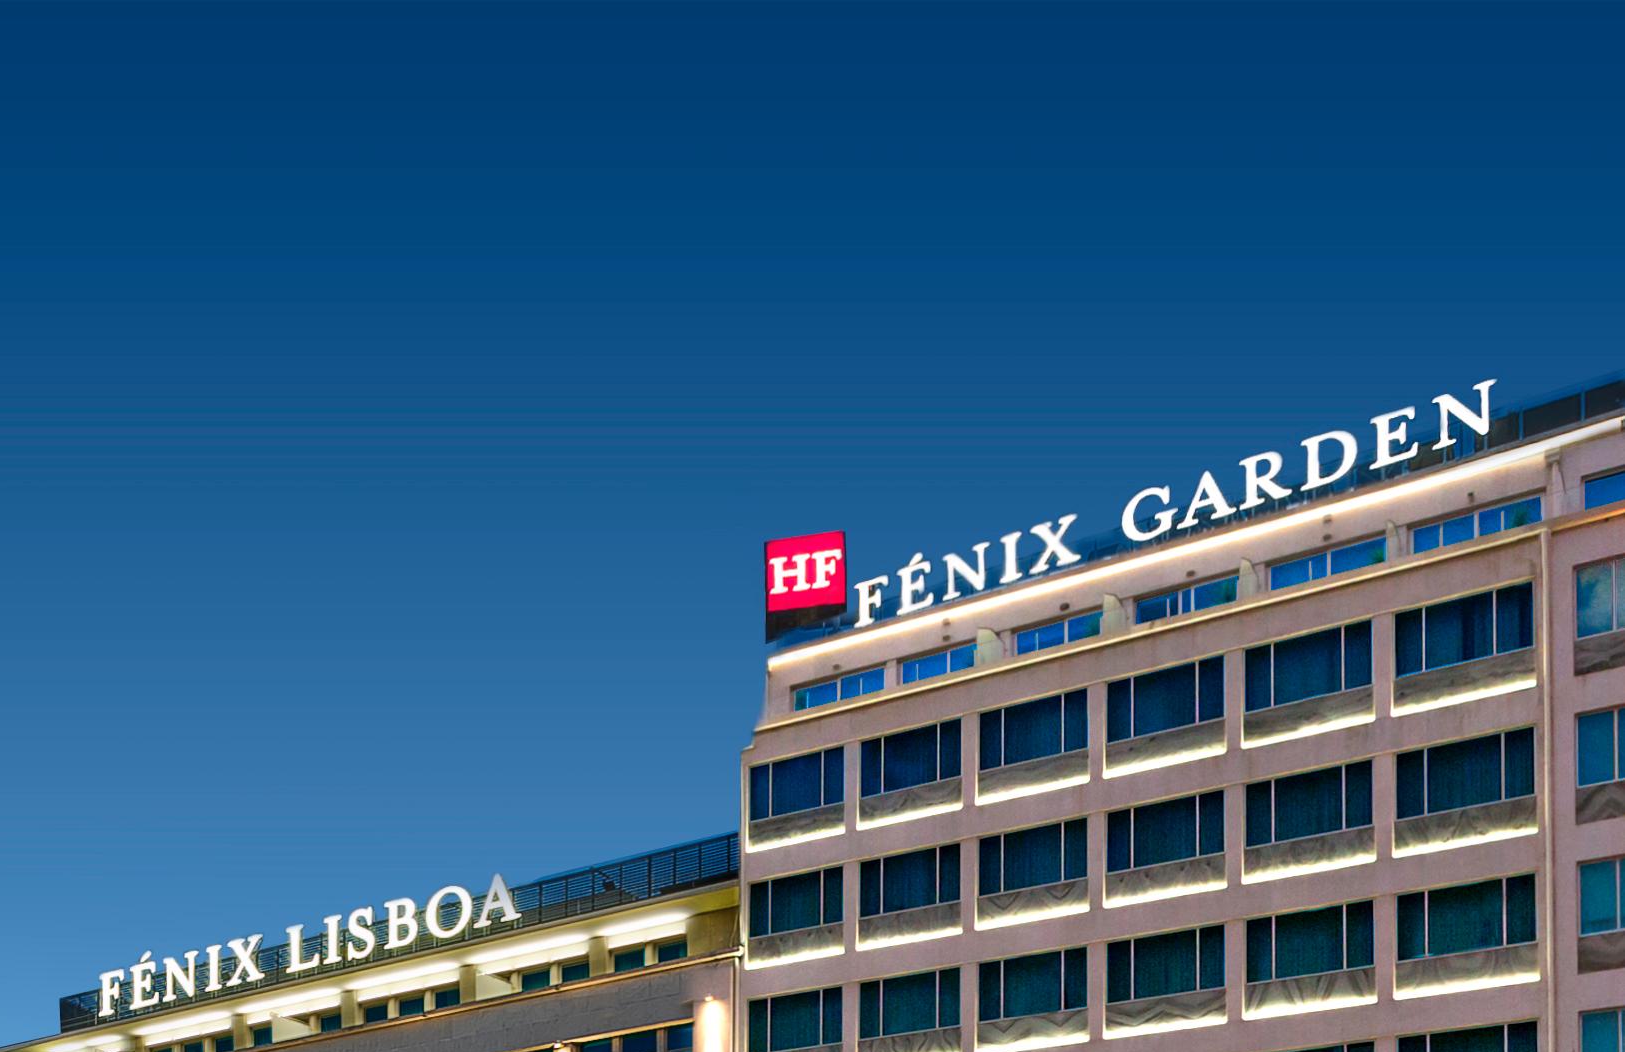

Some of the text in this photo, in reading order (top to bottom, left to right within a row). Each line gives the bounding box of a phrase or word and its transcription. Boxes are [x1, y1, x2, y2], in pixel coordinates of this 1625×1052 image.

[769, 378, 1497, 628] HF FÉNIX GARDEN
[97, 872, 523, 1018] FÉNIX LISBOA
